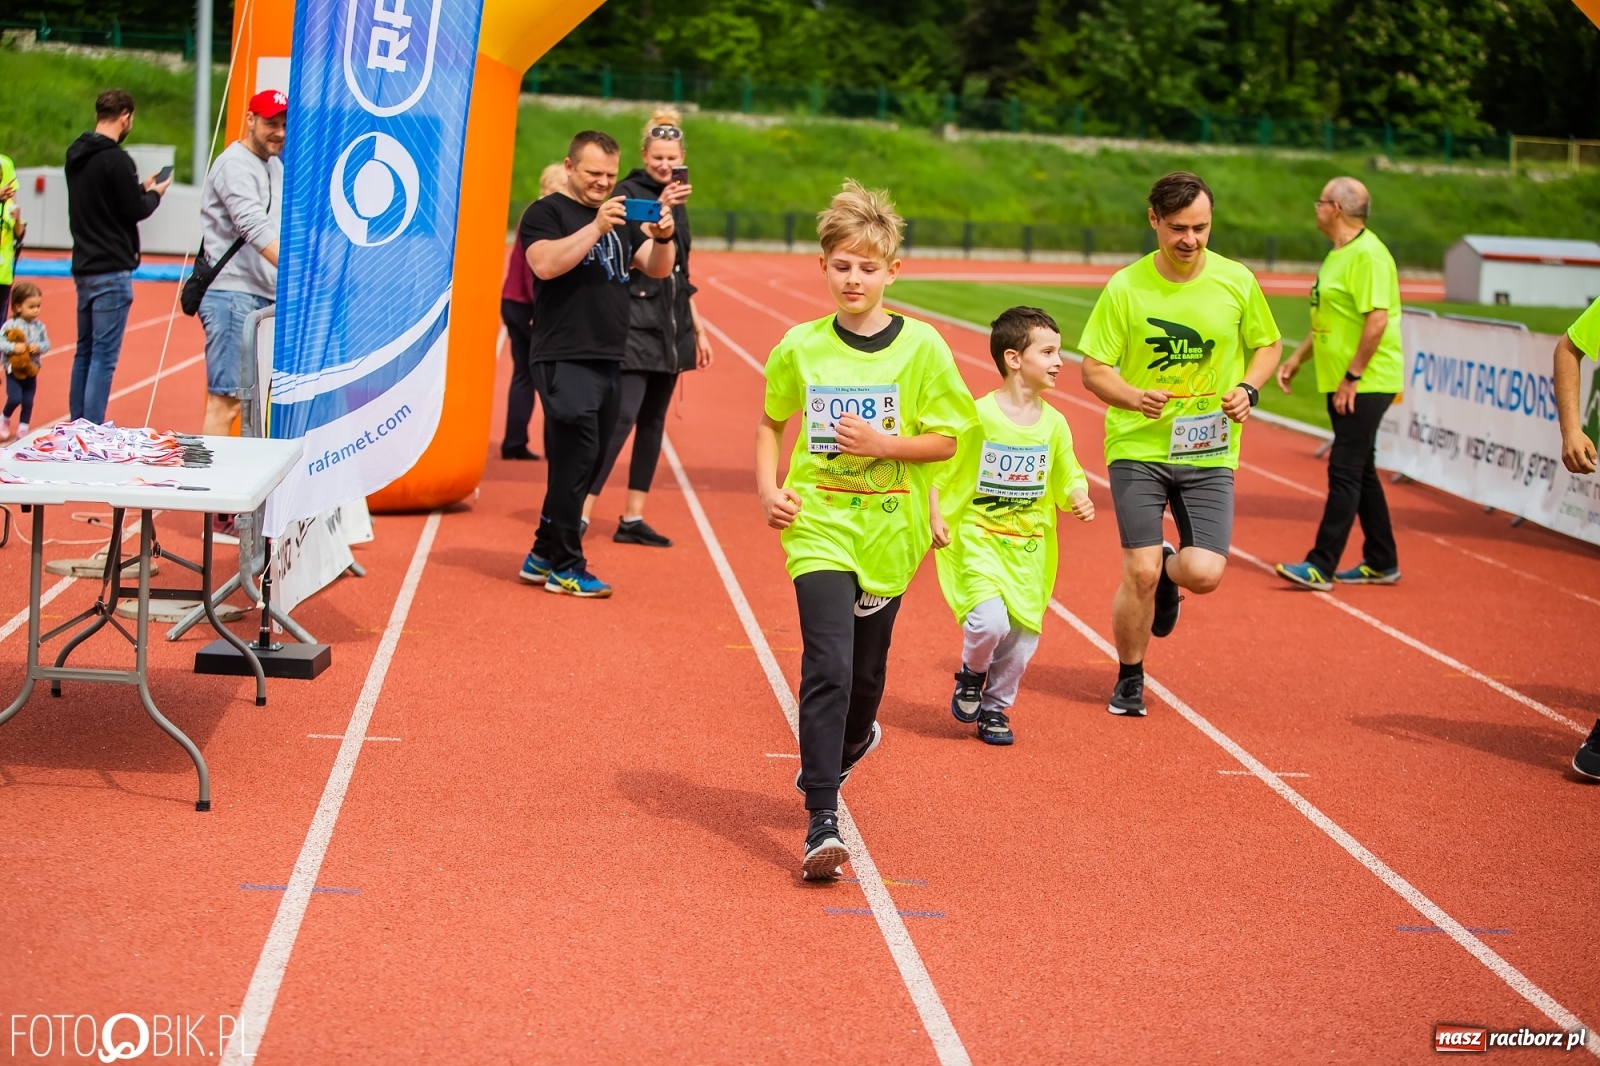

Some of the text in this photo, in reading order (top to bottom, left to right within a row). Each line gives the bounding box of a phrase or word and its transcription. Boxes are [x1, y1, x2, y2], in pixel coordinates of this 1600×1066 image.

[1169, 339, 1188, 354] VI
[830, 398, 877, 420] 008
[884, 397, 894, 408] R
[308, 404, 412, 476] rafamet.com
[1188, 424, 1217, 442] 081
[1000, 454, 1036, 473] 078
[1040, 454, 1046, 463] R
